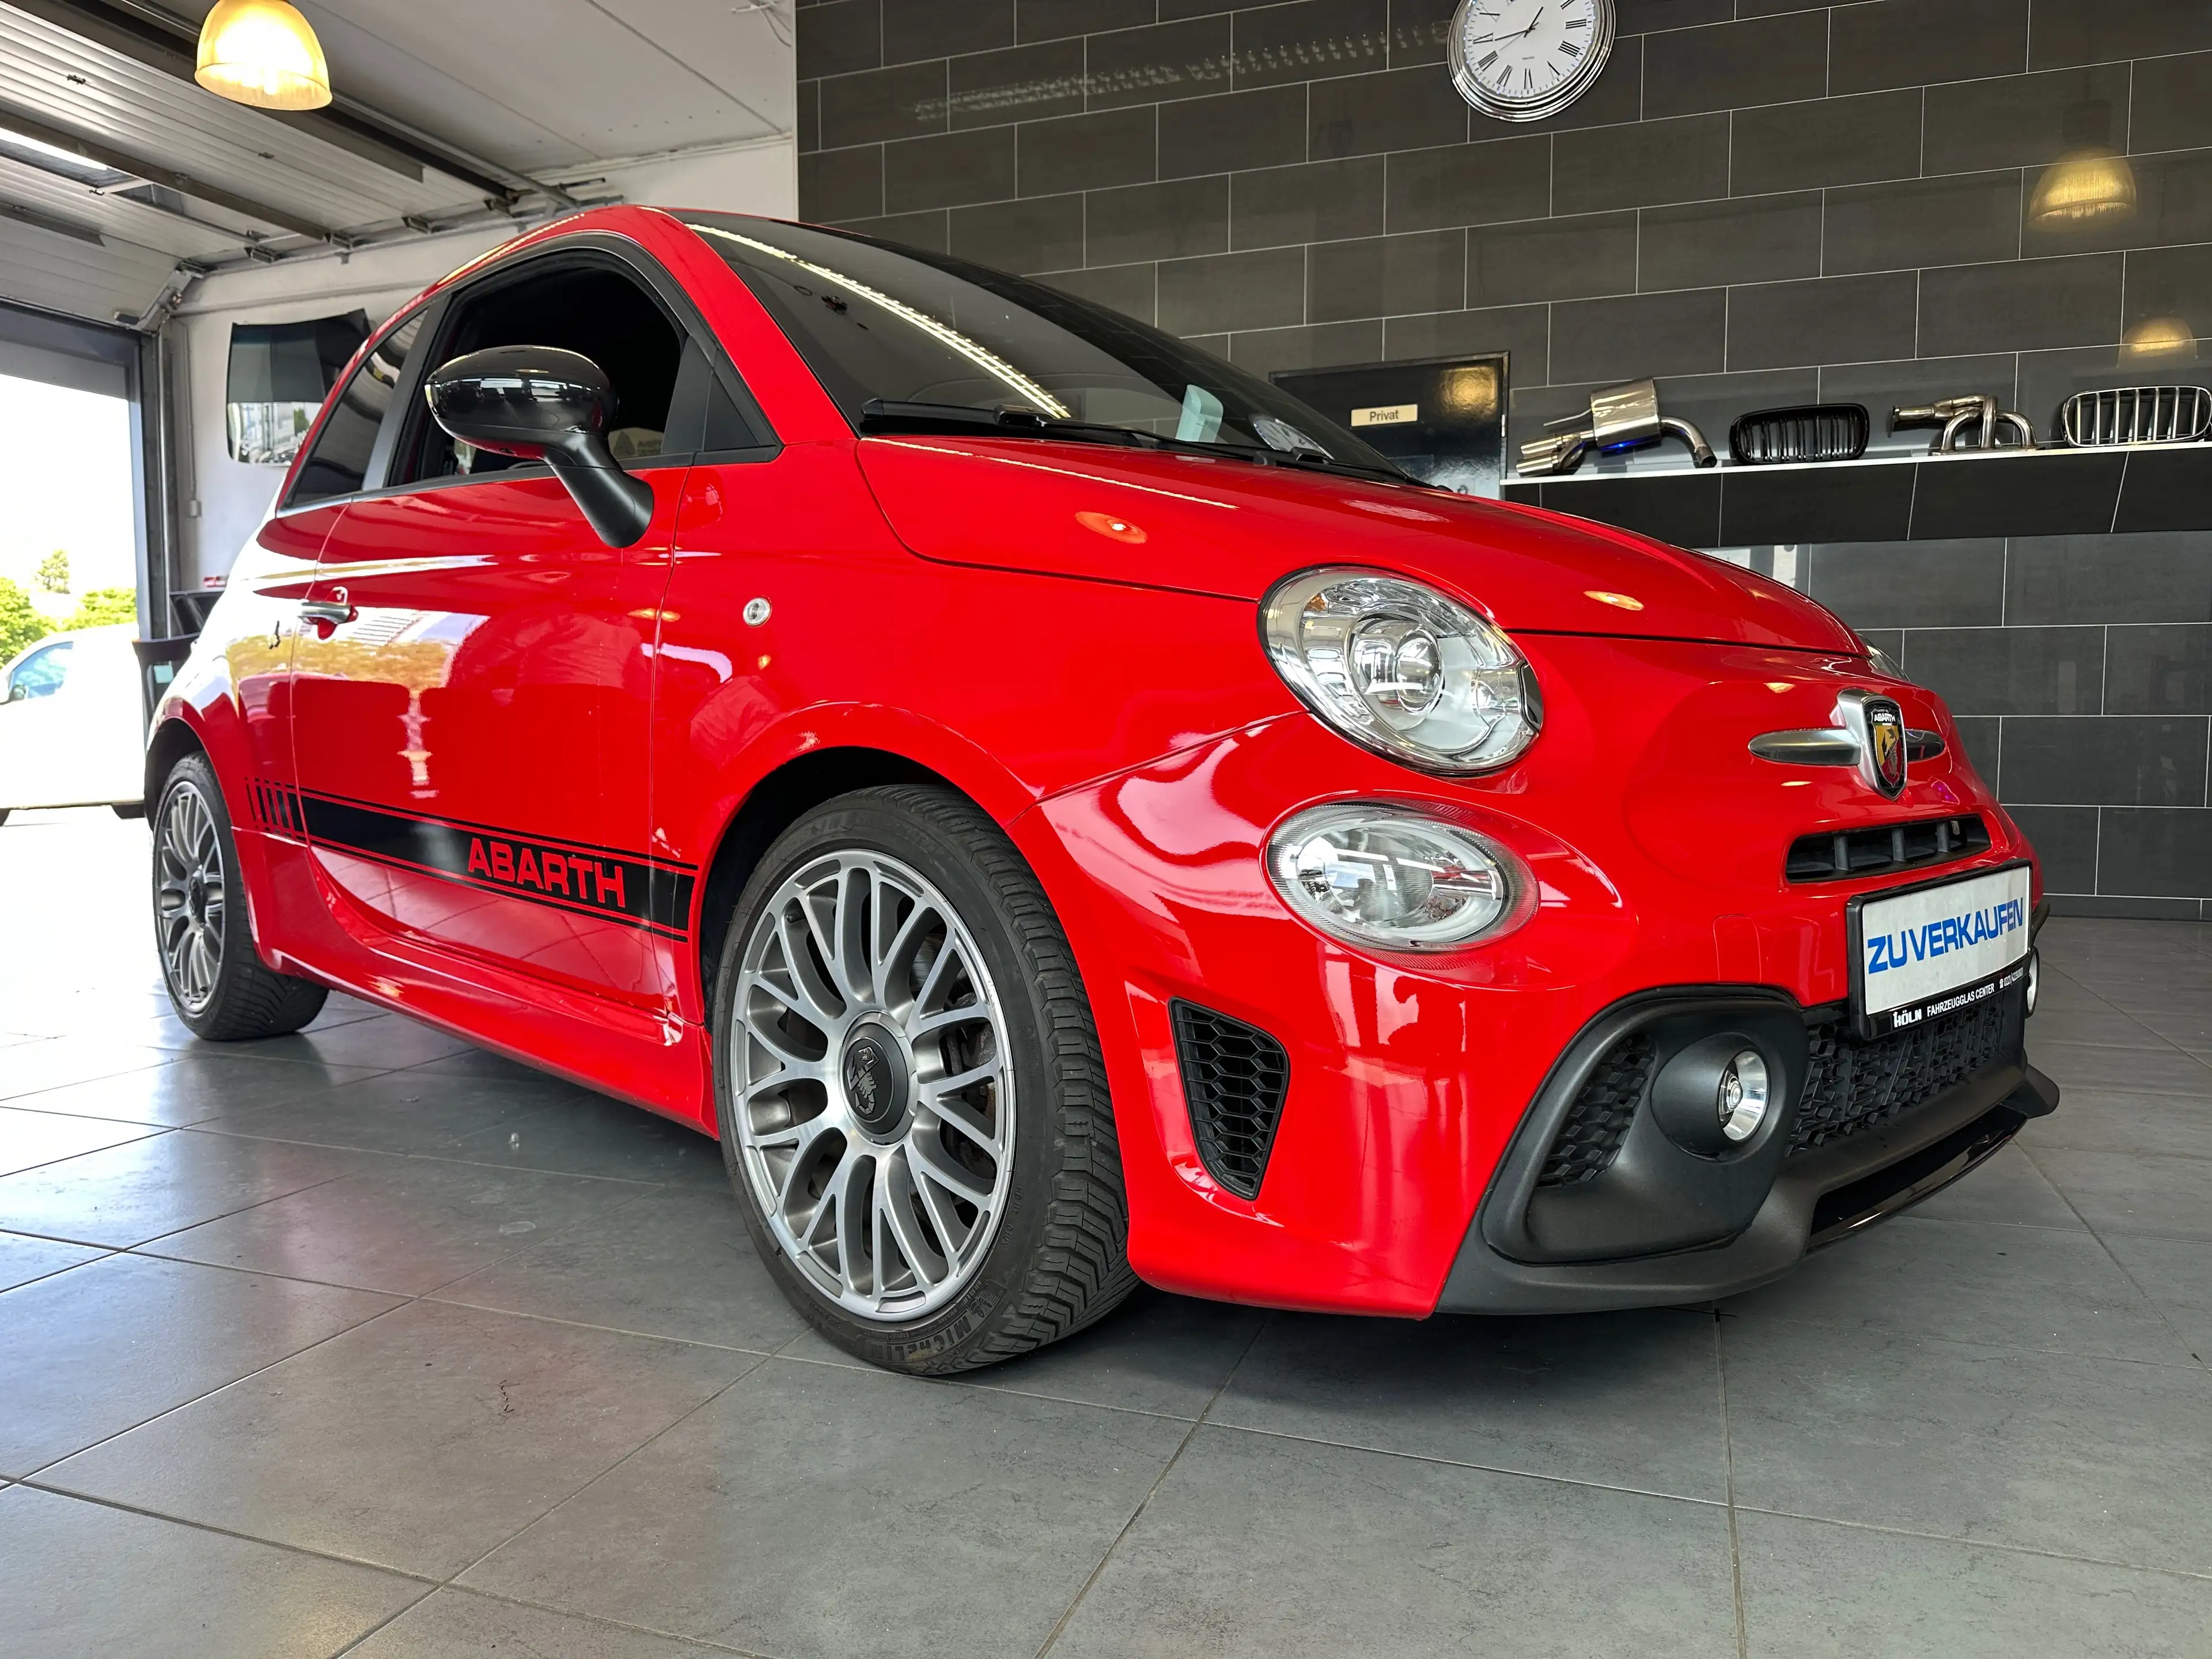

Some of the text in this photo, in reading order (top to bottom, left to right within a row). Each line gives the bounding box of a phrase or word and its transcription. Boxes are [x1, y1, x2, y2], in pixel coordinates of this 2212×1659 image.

[1479, 6, 1501, 22] X
[1565, 18, 1587, 29] III
[1472, 32, 1494, 44] IX
[1558, 40, 1581, 58] IIII
[1477, 50, 1499, 72] VIII
[1546, 60, 1560, 79] V
[1496, 65, 1513, 88] VII
[1524, 67, 1533, 90] VI
[1369, 410, 1399, 422] Privat
[1874, 713, 1896, 722] ABARTH
[468, 837, 626, 908] ABARTH
[1893, 983, 1995, 1028] KÖLN FAHRZEUGGLAS CENTER
[870, 1315, 972, 1361] MICHELIN
